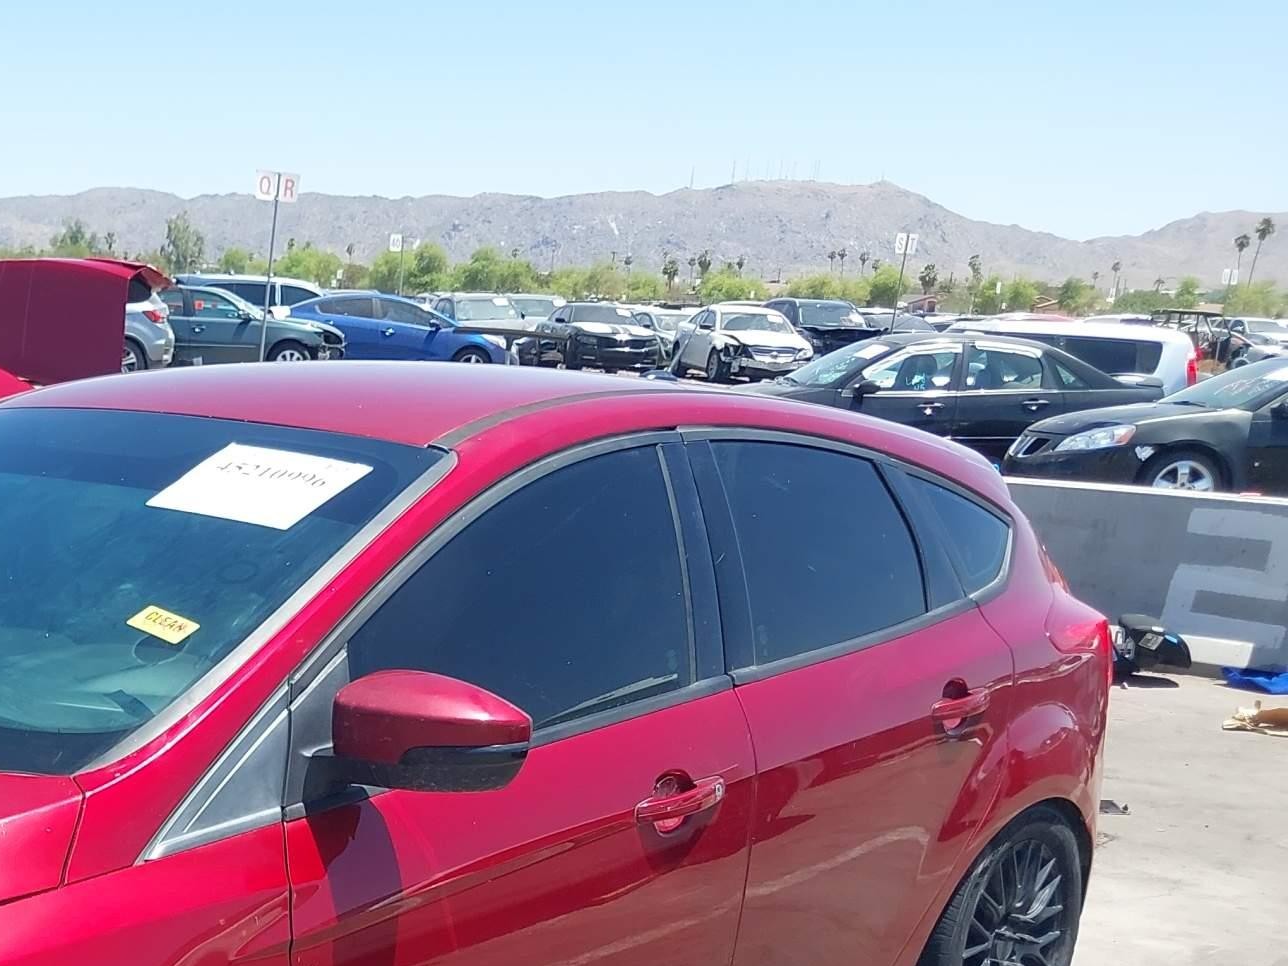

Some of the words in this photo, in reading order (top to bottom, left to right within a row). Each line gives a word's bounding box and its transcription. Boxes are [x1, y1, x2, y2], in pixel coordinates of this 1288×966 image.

[259, 175, 271, 196] Q
[283, 178, 295, 199] R
[144, 611, 188, 633] CLEAN
